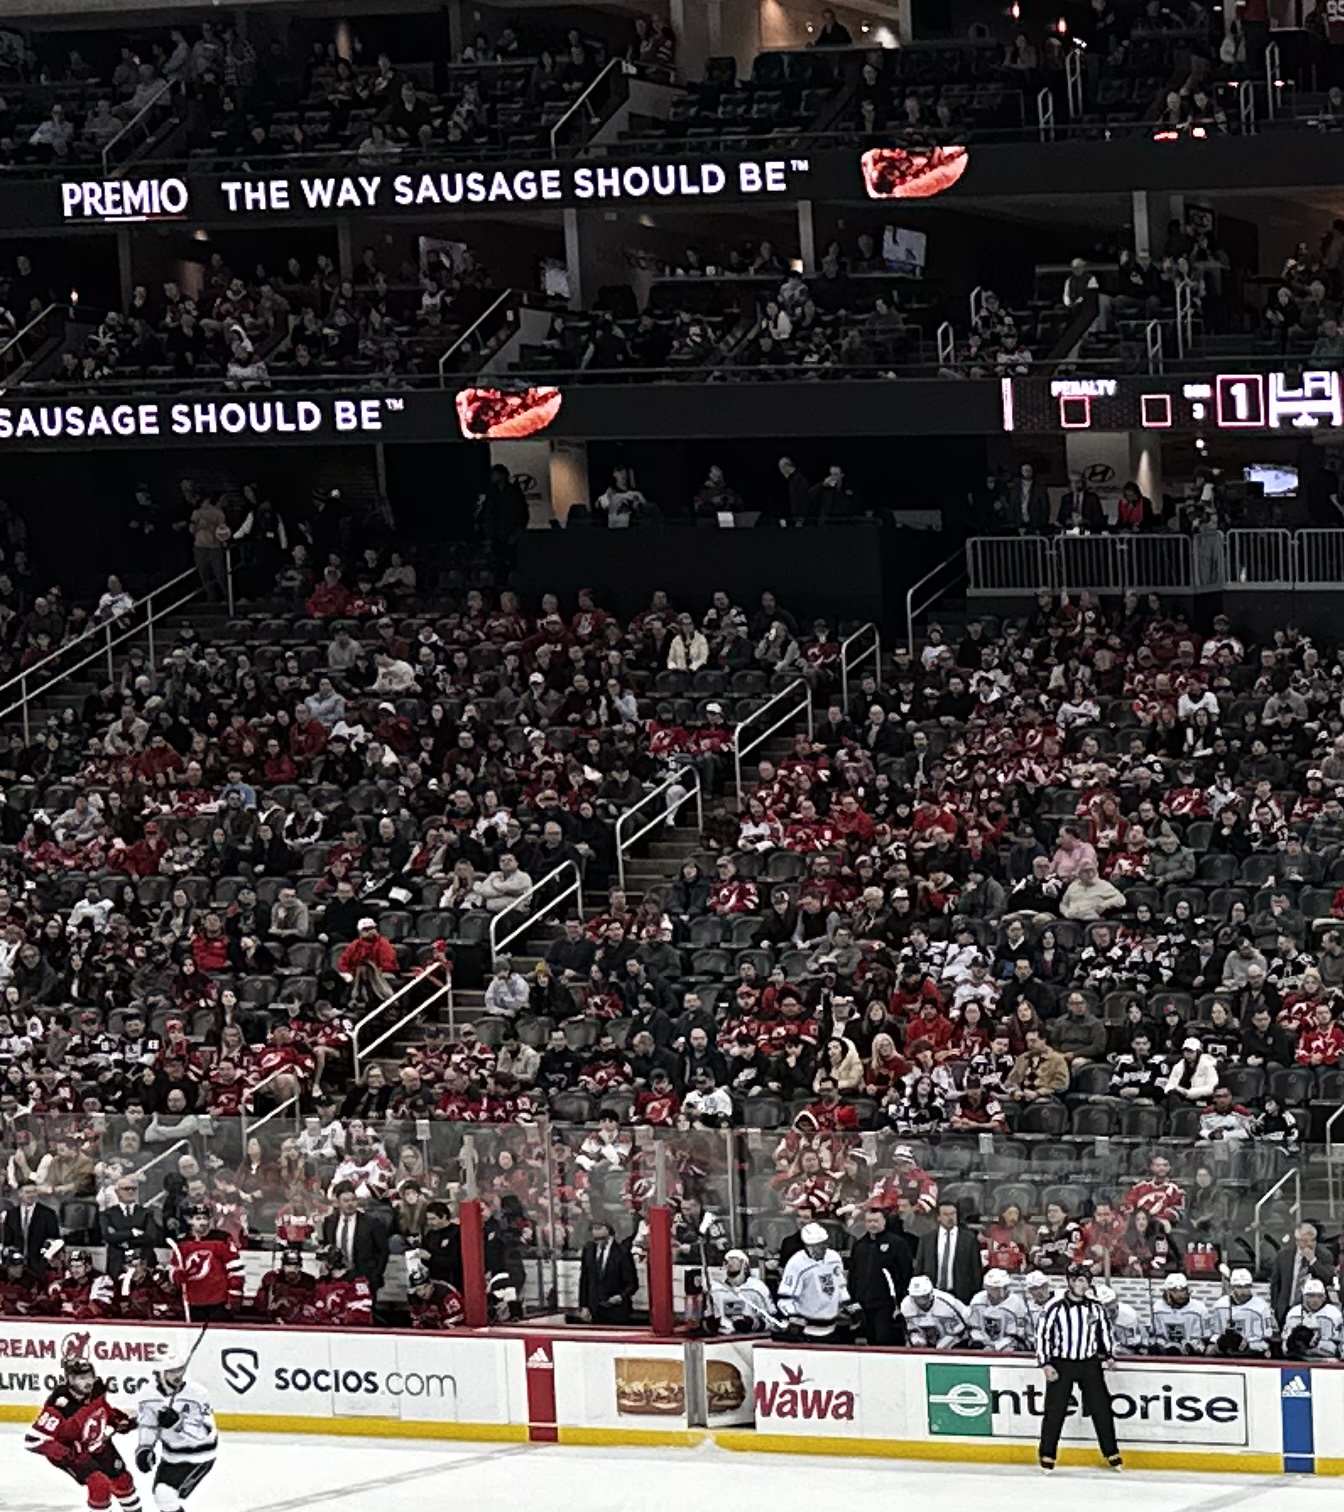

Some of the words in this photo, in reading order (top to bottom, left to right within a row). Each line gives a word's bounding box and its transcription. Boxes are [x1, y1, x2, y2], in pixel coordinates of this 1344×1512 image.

[62, 178, 189, 217] PREMIO
[221, 180, 290, 211] THE
[301, 176, 381, 208] WAY
[394, 170, 562, 204] SAUSAGE
[575, 163, 726, 197] SHOULD
[0, 404, 160, 438] SAUSAGE
[172, 400, 322, 434] SHOULD
[1230, 383, 1248, 419] 1
[755, 1381, 855, 1421] Wawa
